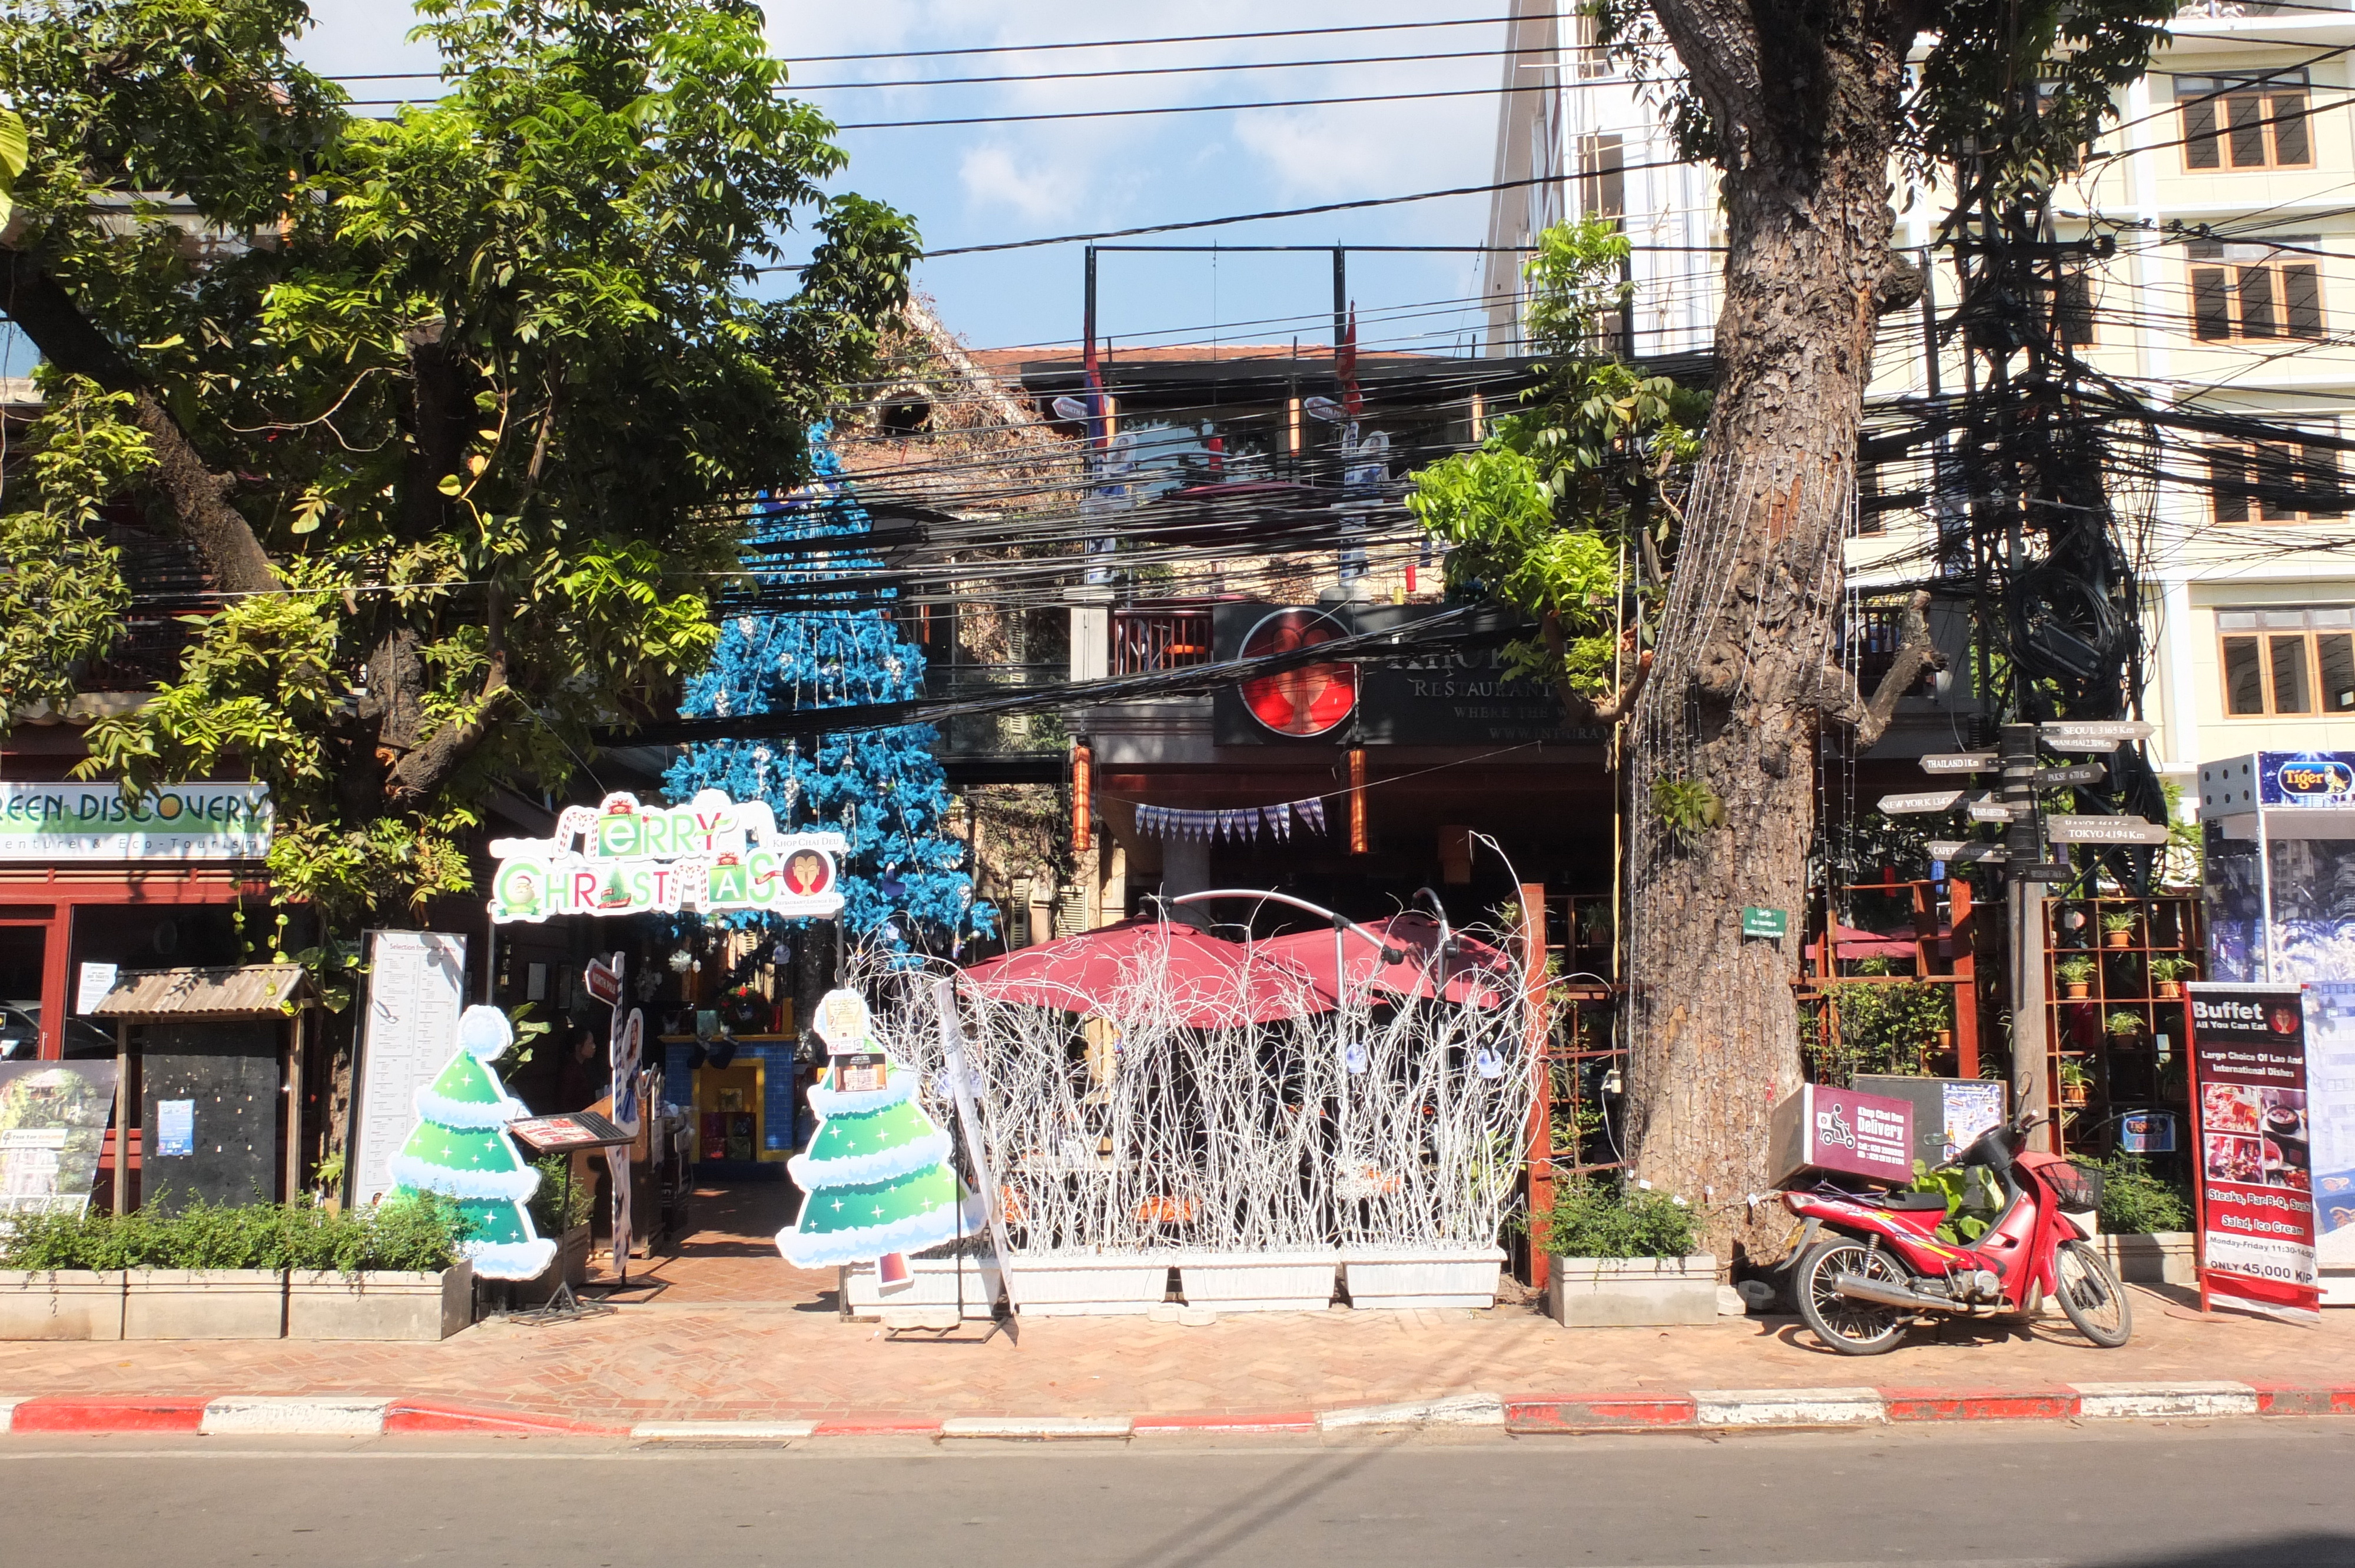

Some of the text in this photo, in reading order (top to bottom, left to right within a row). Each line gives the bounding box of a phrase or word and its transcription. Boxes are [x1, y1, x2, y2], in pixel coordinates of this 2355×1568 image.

[1060, 403, 1080, 415] NORTH
[1414, 680, 1552, 697] RESTAURANT
[2064, 726, 2095, 735] SEOUL
[1926, 759, 1963, 768] THAILAND
[2284, 769, 2324, 790] Tiger
[80, 792, 268, 823] DISCOVERY
[1882, 800, 1903, 809] NEW
[1904, 798, 1931, 807] YORK
[2069, 829, 2104, 838] TOKYO
[2129, 830, 2145, 839] Km
[93, 838, 102, 849] &
[119, 838, 257, 849] Eco-Tourism
[773, 837, 839, 848] KHOP CHAI DEU
[2192, 1001, 2264, 1020] Buffet
[2230, 1021, 2250, 1030] Can
[2251, 1022, 2268, 1031] Eat
[2201, 1051, 2303, 1065] Large Choice Of Lao And
[2213, 1064, 2295, 1078] International Dishes
[1857, 1117, 1903, 1141] Delivery
[2208, 1190, 2246, 1205] Steaks,
[2248, 1193, 2288, 1211] Bar-B-Q,
[2222, 1215, 2304, 1235] Salad, Ice Cream
[2210, 1237, 2268, 1251] Monday-Friday
[2211, 1260, 2313, 1283] ONLY 45,000 KIP
